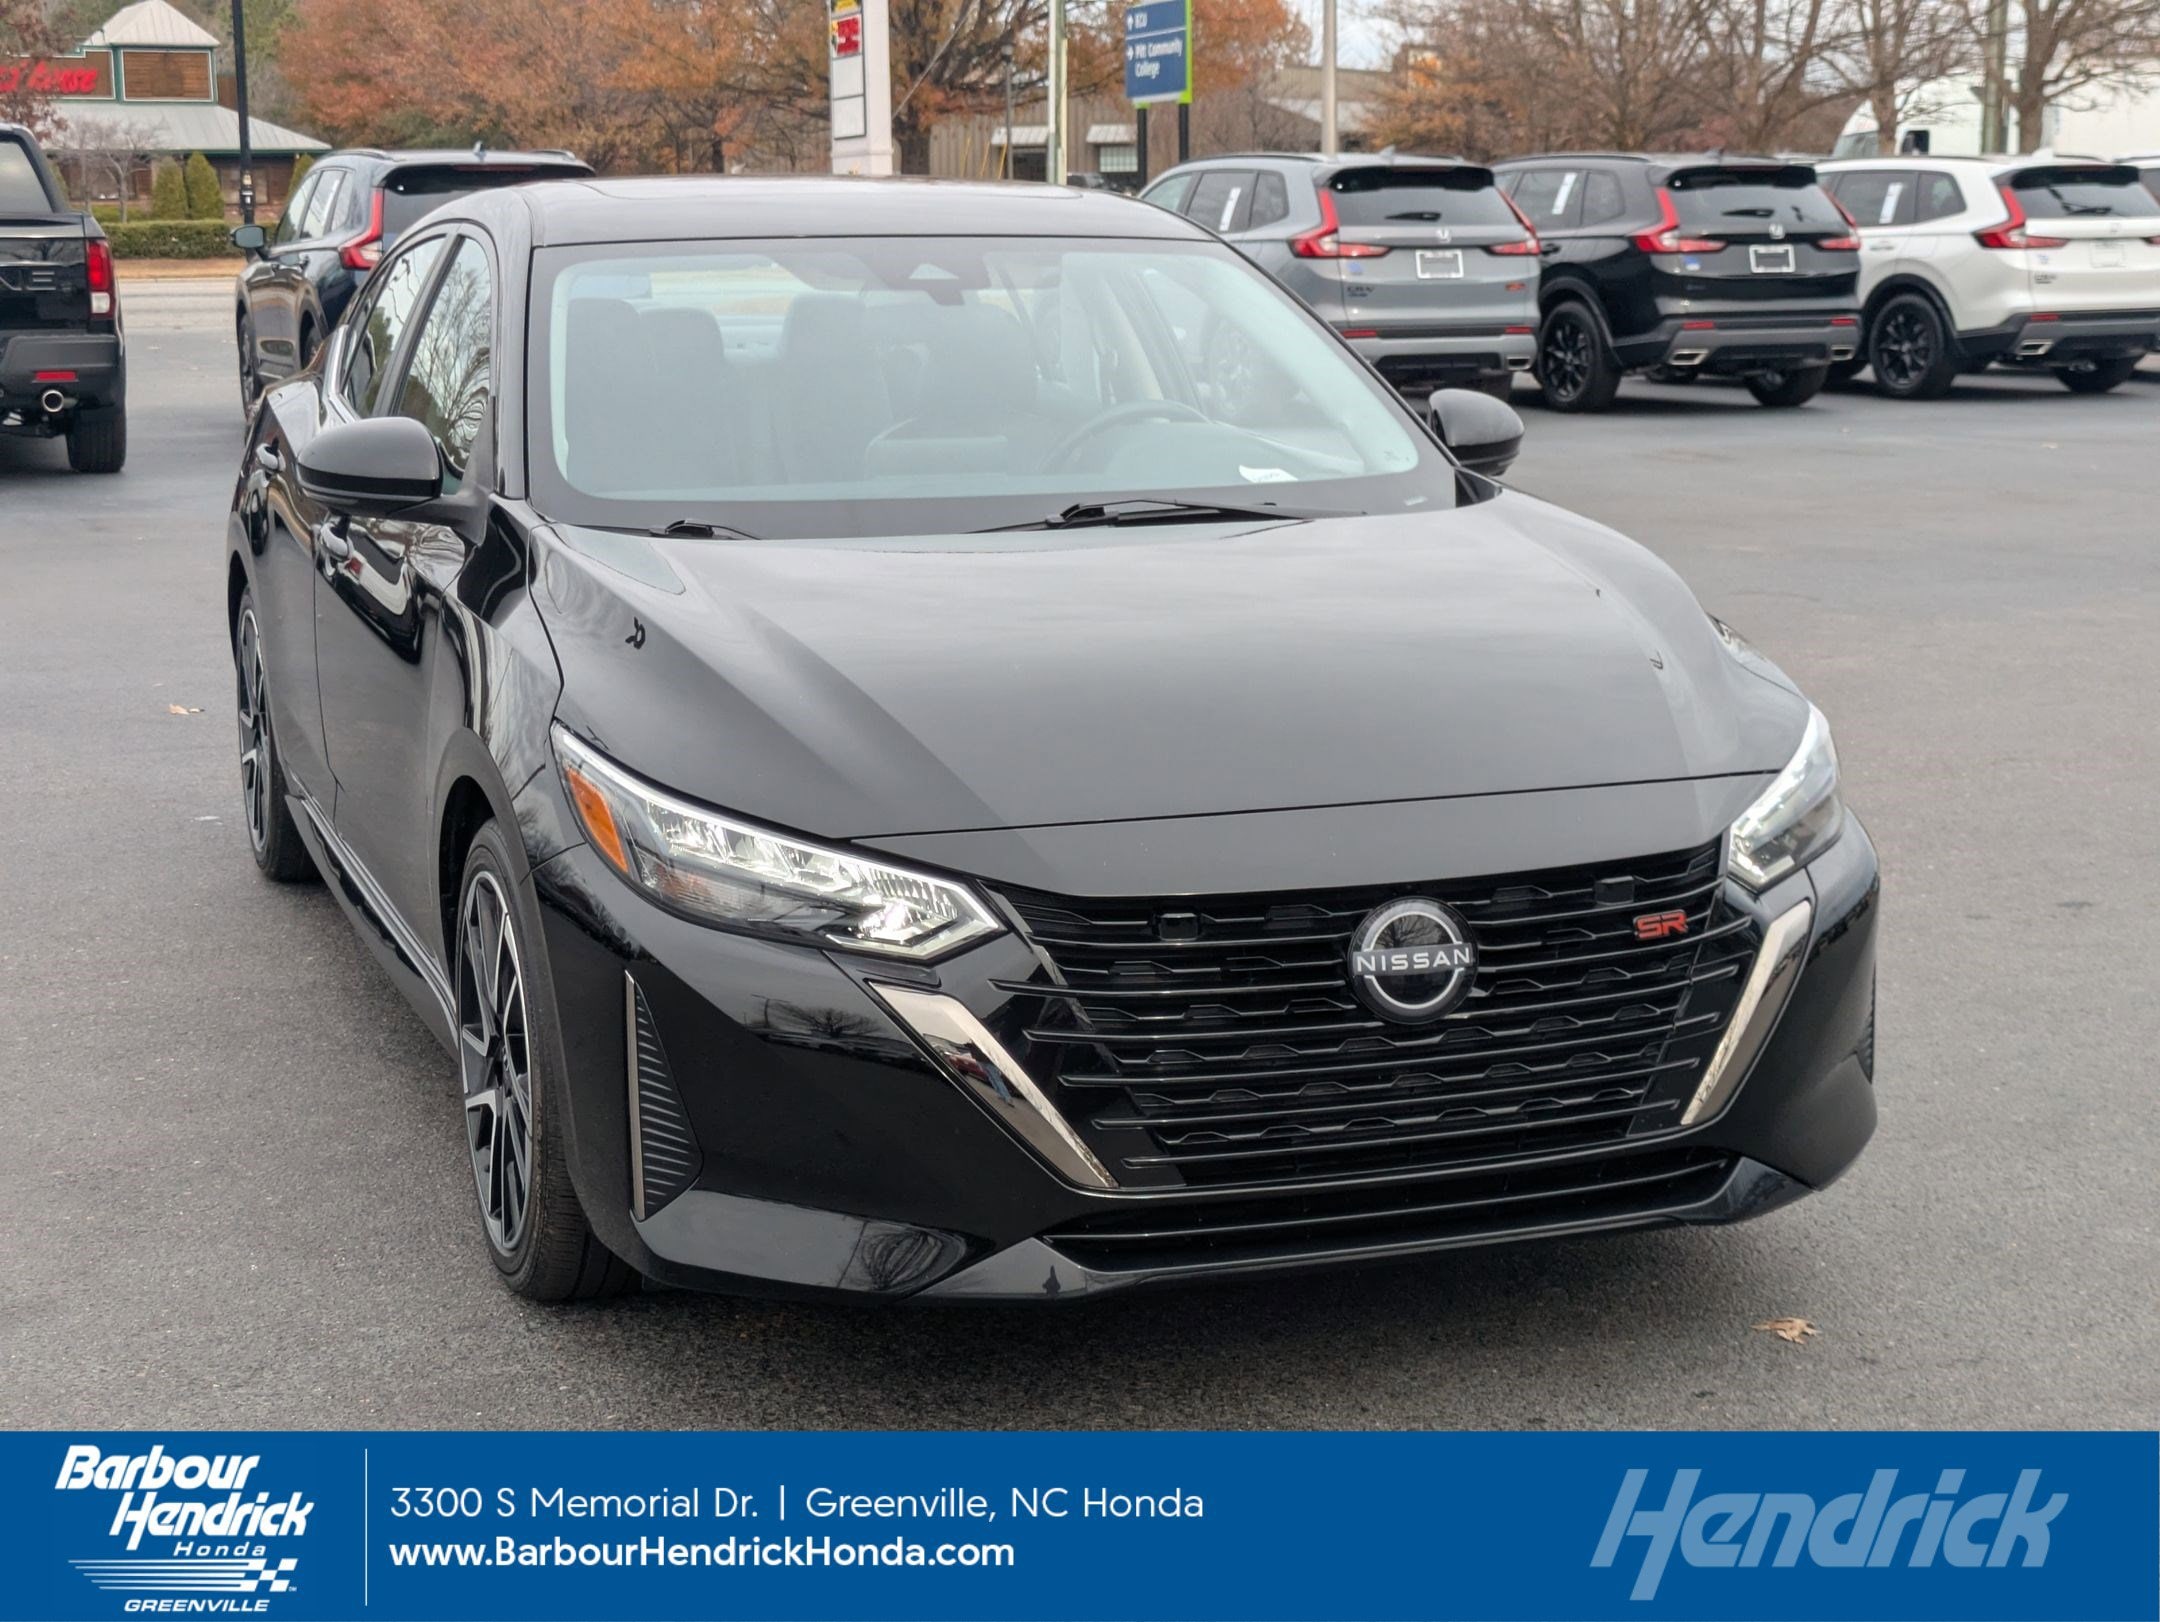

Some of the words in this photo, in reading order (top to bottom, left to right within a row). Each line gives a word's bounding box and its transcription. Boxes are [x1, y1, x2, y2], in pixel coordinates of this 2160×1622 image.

[1147, 37, 1183, 58] Community
[1134, 60, 1160, 79] College
[1633, 909, 1688, 941] SR
[1356, 948, 1471, 973] NISSAN
